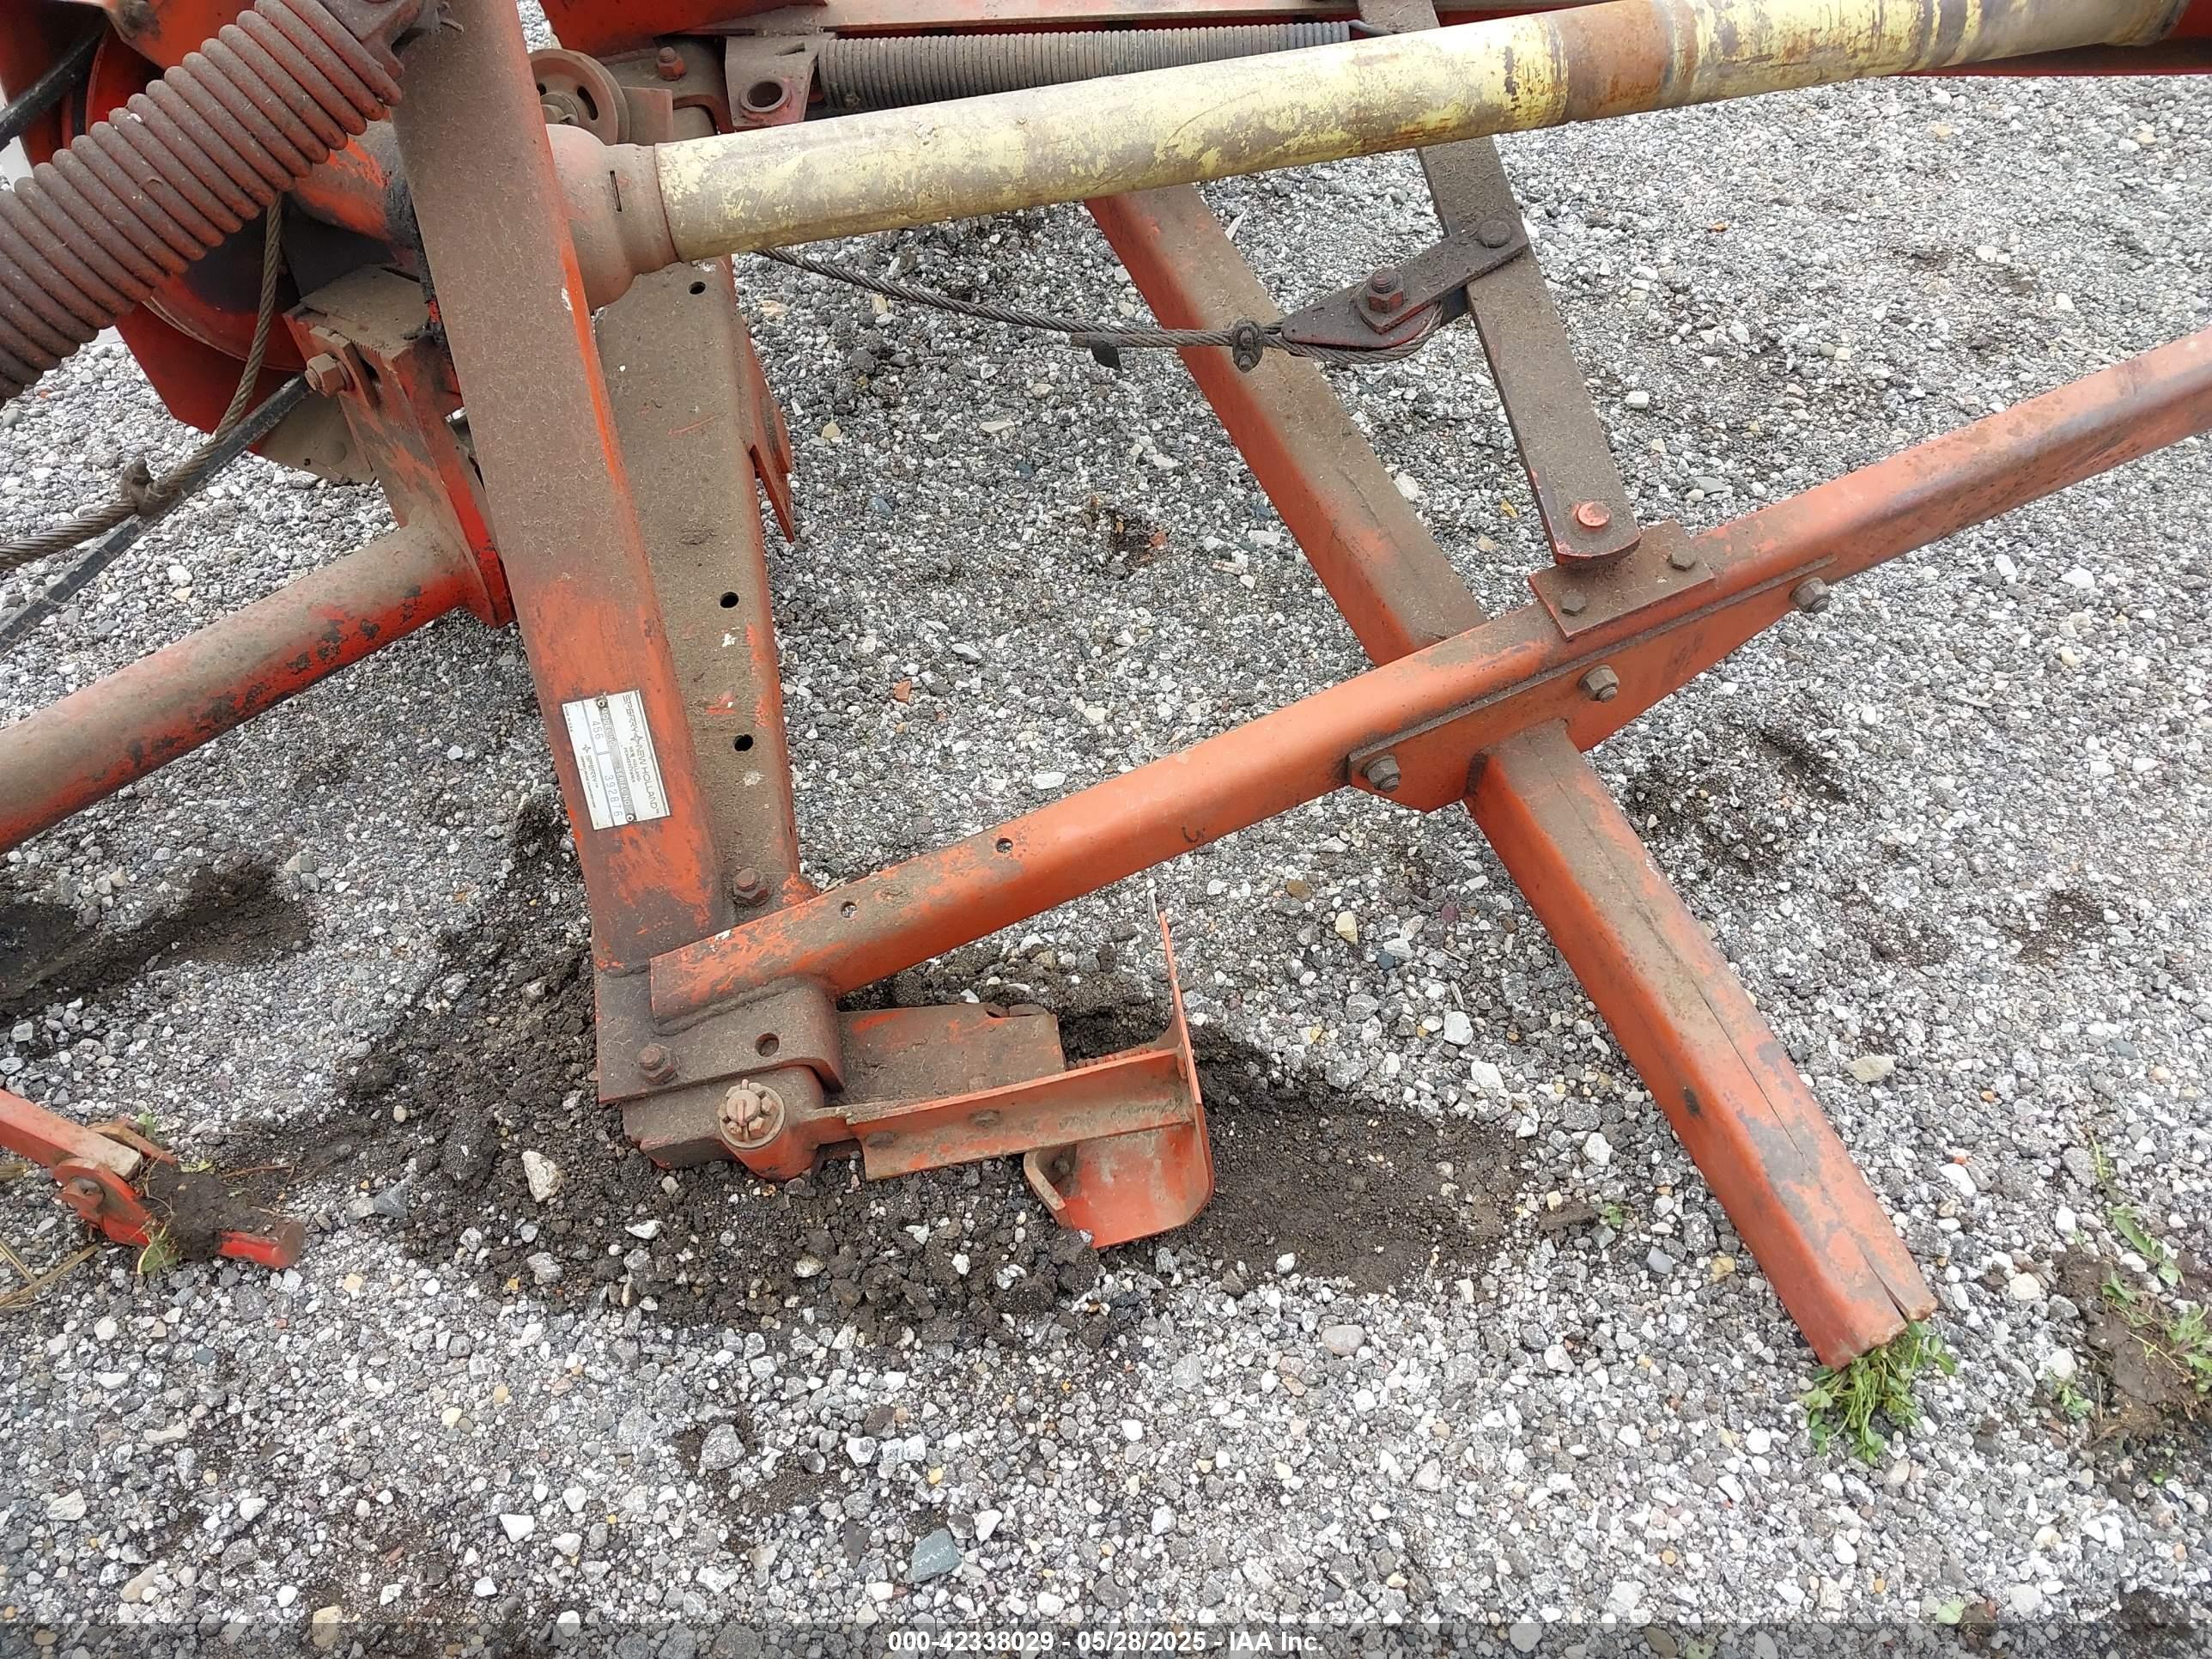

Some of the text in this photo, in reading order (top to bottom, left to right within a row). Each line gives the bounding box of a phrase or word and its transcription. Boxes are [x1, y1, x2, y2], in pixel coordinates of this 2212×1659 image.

[591, 720, 604, 740] 456
[623, 695, 639, 732] SPERRY
[635, 744, 647, 765] NEW
[615, 767, 627, 791] SERIAL
[603, 775, 623, 817] 392876
